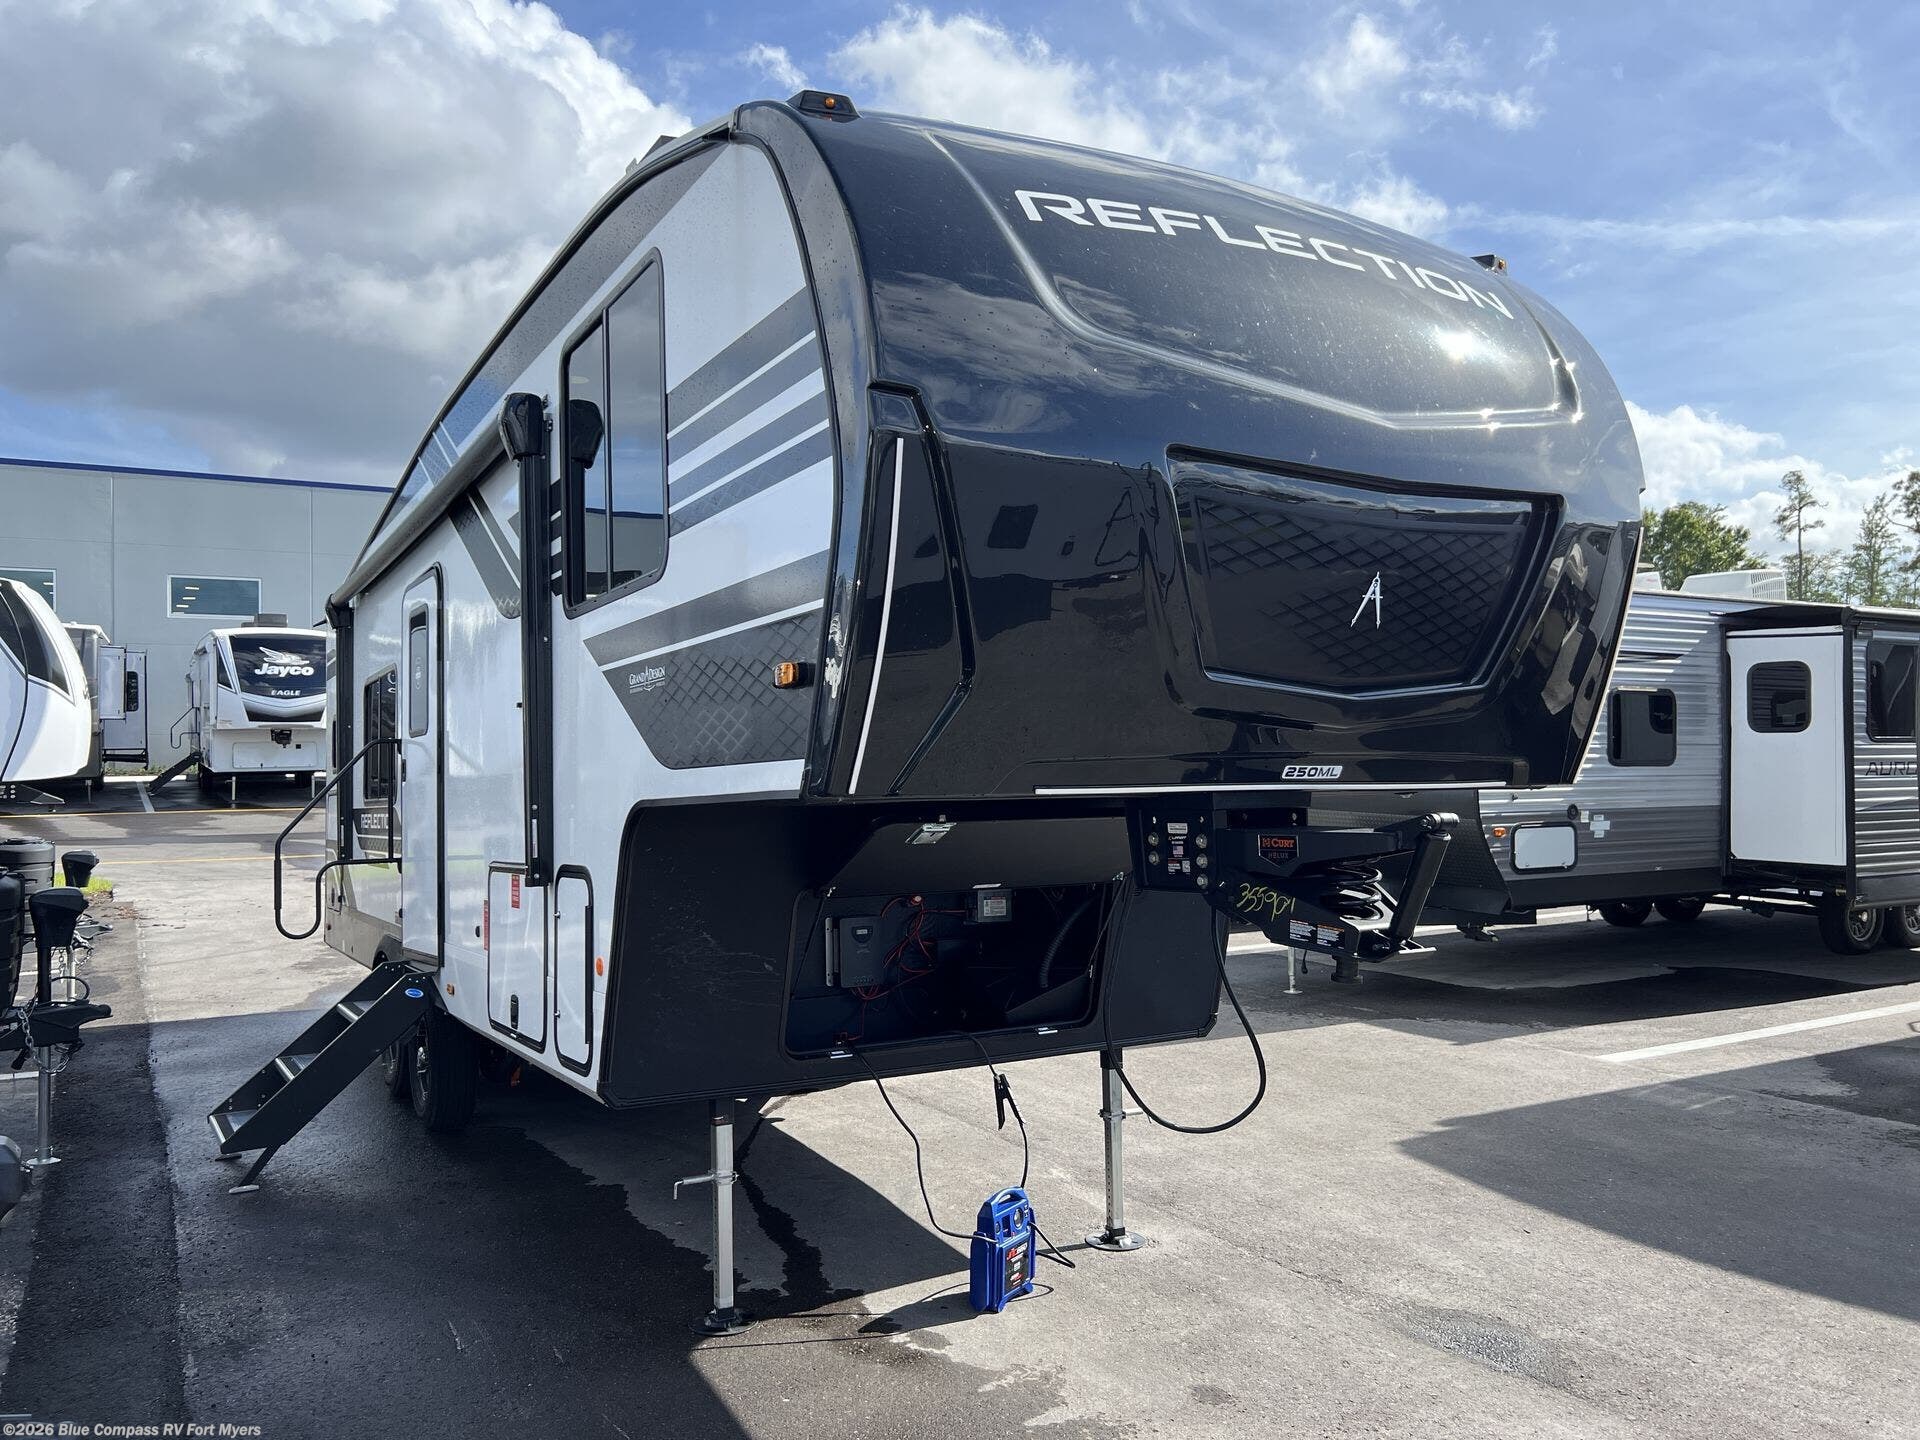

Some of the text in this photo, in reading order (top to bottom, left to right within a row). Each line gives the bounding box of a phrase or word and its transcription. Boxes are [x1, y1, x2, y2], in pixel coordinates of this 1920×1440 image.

[1014, 189, 1514, 318] REFLECTION
[254, 663, 315, 677] Jayco
[1284, 766, 1339, 778] 250ML
